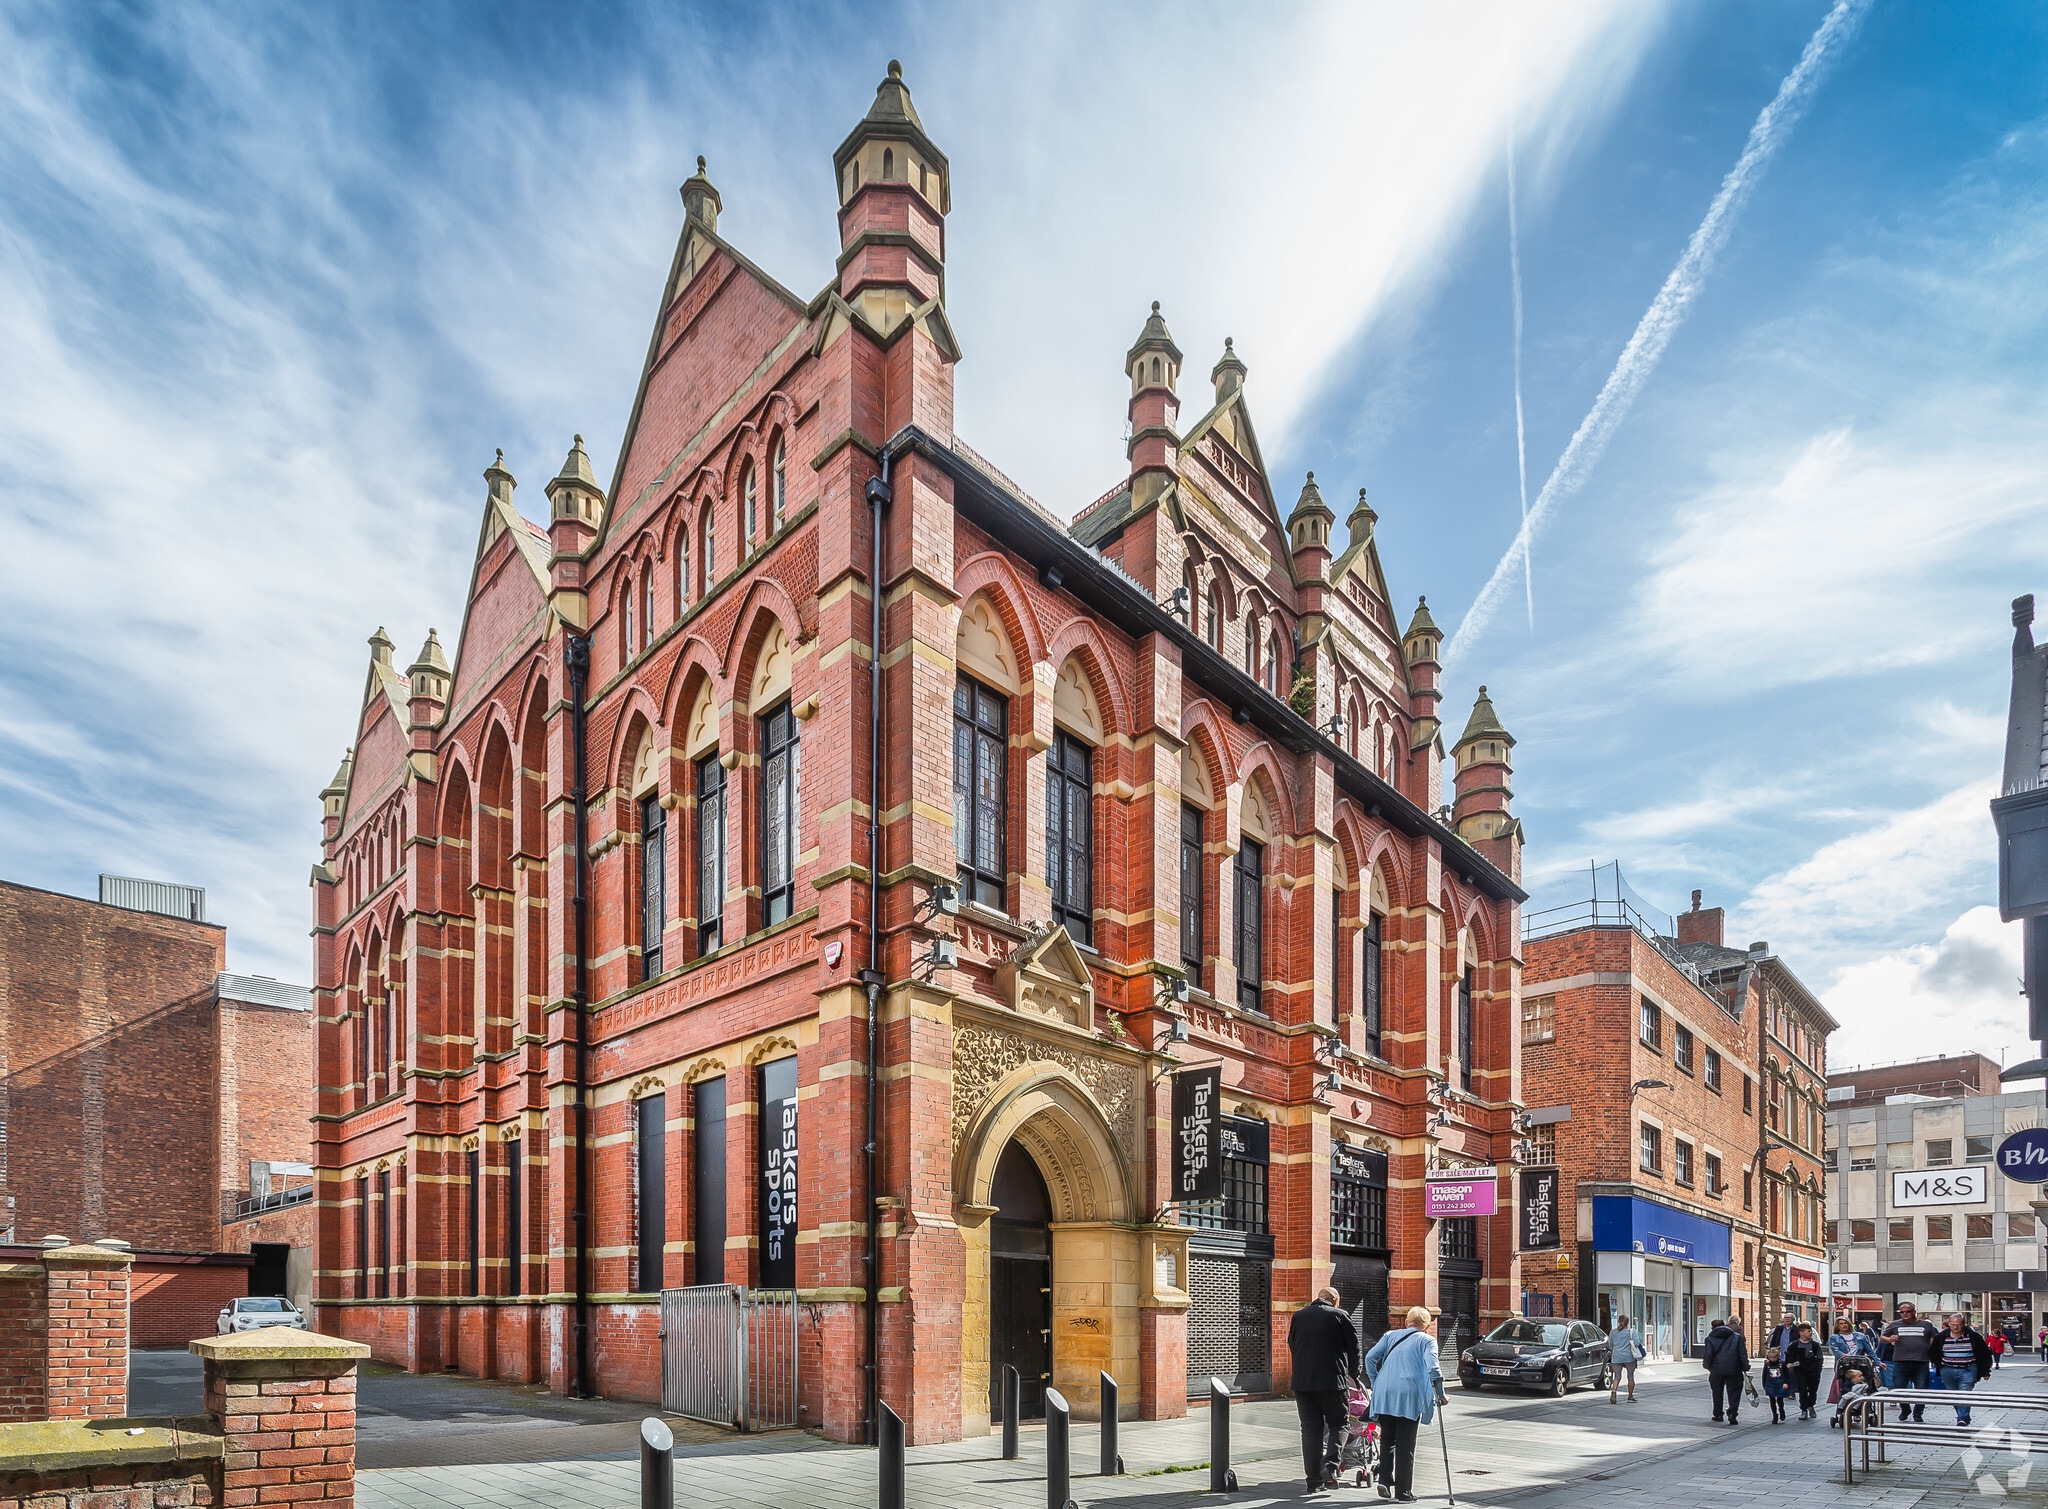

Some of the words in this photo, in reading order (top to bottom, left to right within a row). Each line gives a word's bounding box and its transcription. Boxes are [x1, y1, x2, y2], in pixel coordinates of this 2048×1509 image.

[1195, 1077, 1212, 1169] Taskers
[1221, 1129, 1238, 1141] kers
[1221, 1138, 1245, 1152] ports
[783, 1087, 798, 1225] Taskers
[1180, 1115, 1199, 1192] sports
[1338, 1153, 1365, 1169] Taskers
[2004, 1142, 2048, 1166] Bh
[1347, 1166, 1370, 1179] sports
[1431, 1185, 1473, 1194] mason
[1431, 1193, 1465, 1202] owen
[1904, 1176, 1973, 1199] M&S
[765, 1148, 785, 1261] sports
[1539, 1176, 1552, 1232] Taskers
[1527, 1199, 1543, 1245] sports
[1832, 1278, 1849, 1288] ER
